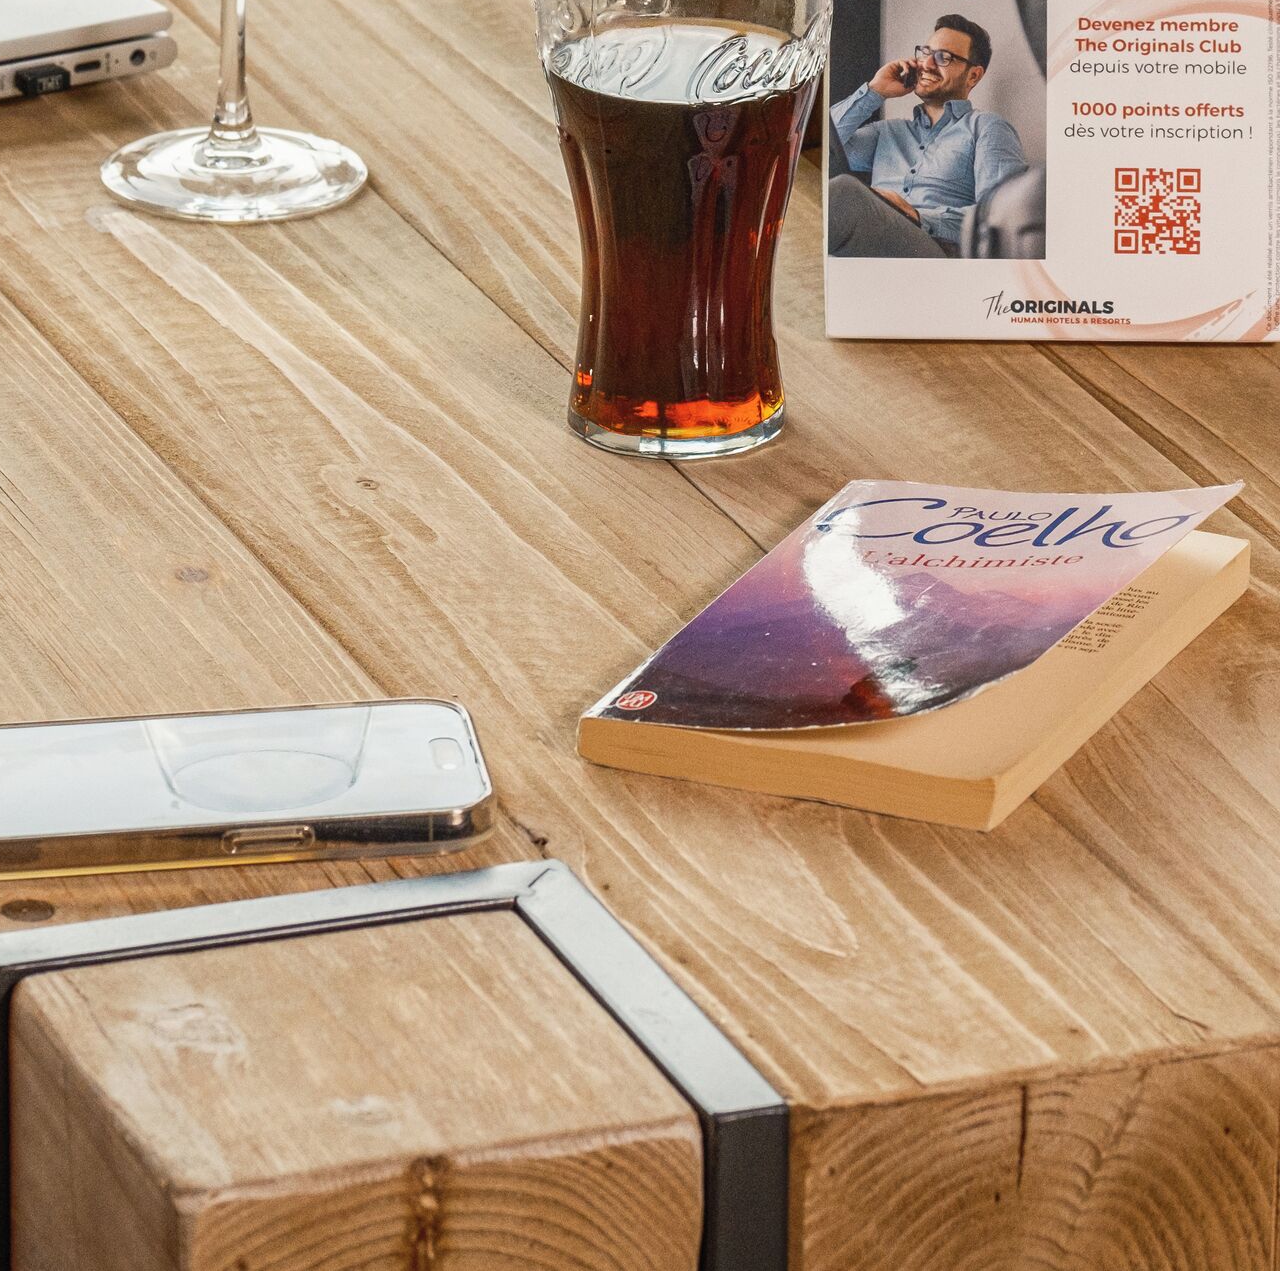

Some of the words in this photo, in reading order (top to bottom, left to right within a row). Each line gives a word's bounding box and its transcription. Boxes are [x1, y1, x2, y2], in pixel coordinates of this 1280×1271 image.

[1078, 17, 1155, 32] Devenez
[1160, 19, 1239, 32] membre
[1075, 38, 1108, 52] The
[1112, 38, 1195, 56] Originals
[1199, 40, 1242, 54] Club
[1070, 60, 1130, 76] depuis
[1135, 62, 1179, 74] votre
[1185, 61, 1247, 75] mobile
[1072, 102, 1117, 116] 1000
[1122, 102, 1180, 119] points
[1184, 103, 1244, 118] offerts
[1064, 124, 1095, 138] dès
[1100, 125, 1145, 139] votre
[1150, 124, 1243, 142] inscription
[982, 290, 1012, 320] The
[1010, 300, 1114, 314] ORIGINALS
[816, 497, 1203, 548] Coelho
[953, 506, 1053, 522] PAULO
